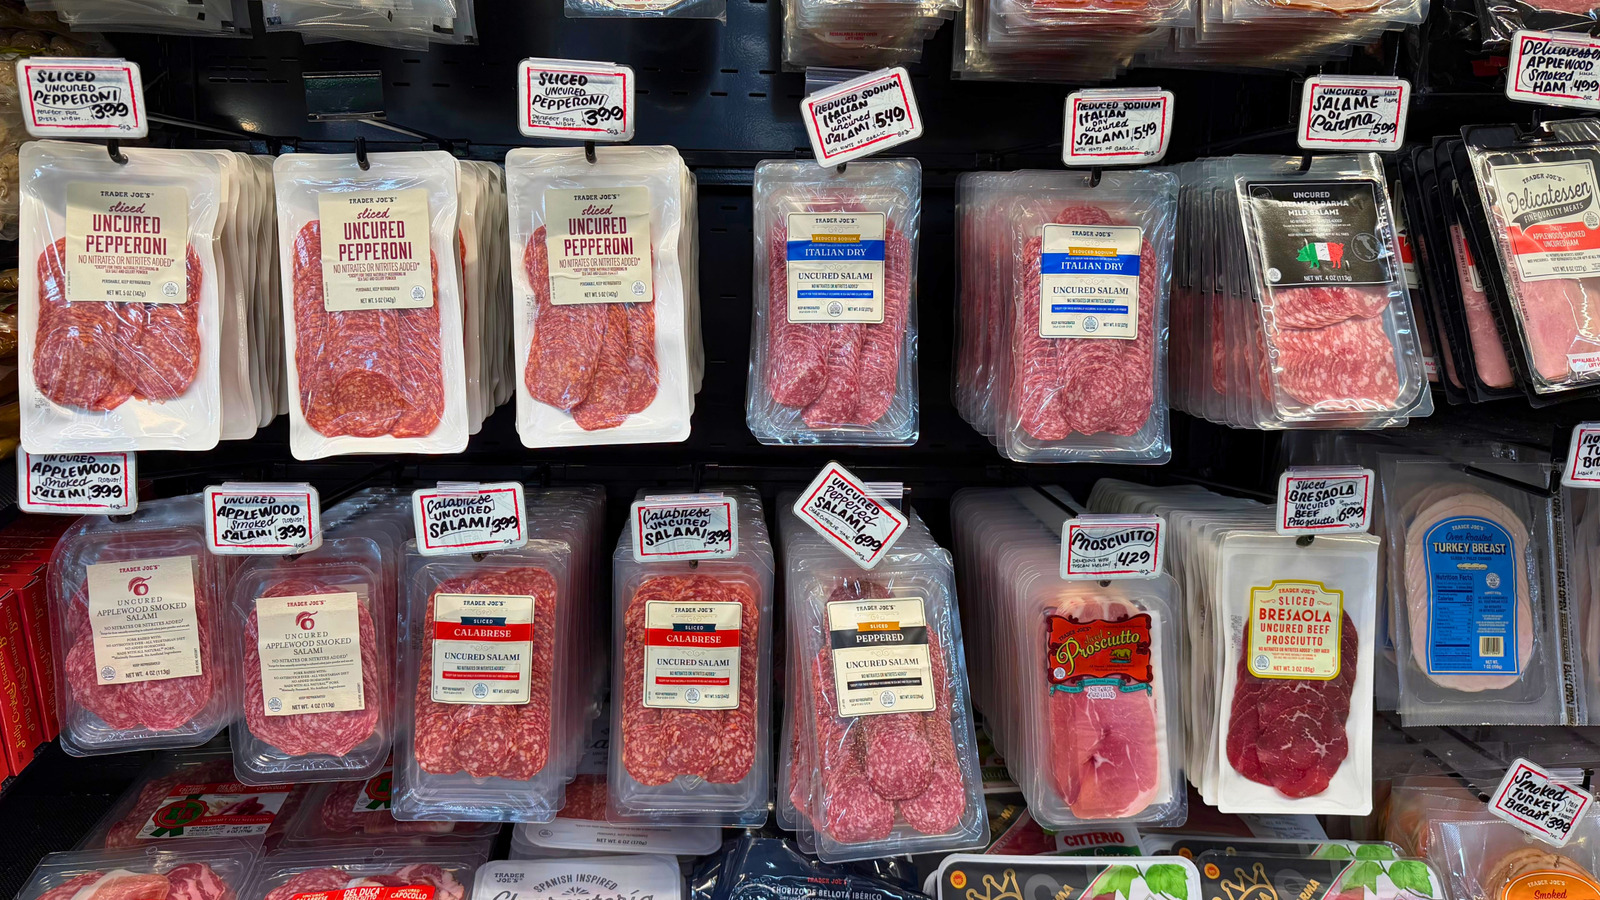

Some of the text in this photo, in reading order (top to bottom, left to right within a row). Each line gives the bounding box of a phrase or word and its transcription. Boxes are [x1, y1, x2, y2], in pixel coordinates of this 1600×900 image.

[1526, 56, 1594, 71] APPLEWOOD
[37, 69, 96, 83] SLICED
[538, 71, 588, 87] SLICED
[1528, 69, 1574, 82] Smoked
[44, 83, 96, 93] UNCURED
[545, 87, 586, 97] UNCURED
[1323, 88, 1368, 96] UNCURED
[1533, 81, 1566, 94] HAM
[33, 90, 118, 105] PEPPERONI
[532, 94, 605, 111] PEPPERONI
[814, 80, 899, 117] REDUCED SODIUM
[1313, 95, 1380, 112] SALAME
[1077, 101, 1161, 111] REDUCED SODIUM
[1311, 113, 1376, 132] Parma
[825, 121, 870, 145] SALAMI
[130, 191, 151, 199] JOE'S
[1506, 181, 1592, 215] Delicatessen
[108, 201, 146, 214] sliced
[356, 207, 391, 220] sliced
[581, 204, 614, 216] sliced
[1288, 209, 1307, 217] MILD
[1523, 203, 1584, 224] FINE QUALITY MEATS
[93, 214, 161, 235] UNCURED
[343, 220, 405, 241] UNCURED
[568, 216, 627, 236] UNCURED
[1533, 232, 1561, 240] APPLEWOOD
[86, 235, 167, 256] PEPPERONI
[338, 242, 413, 262] PEPPERONI
[564, 237, 634, 257] PEPPERONI
[805, 248, 867, 257] ITALIAN DRY
[78, 254, 87, 264] NO
[87, 255, 116, 265] NITRATES
[116, 256, 125, 265] OR
[125, 256, 152, 266] NITRITES
[1061, 261, 1124, 271] ITALIAN DRY
[798, 272, 873, 280] UNCURED SALAMI
[1053, 286, 1129, 295] UNCURED SALAMI
[43, 454, 96, 464] UNCURED
[31, 462, 121, 479] APPLEWOOD
[41, 476, 94, 488] Smoked
[1295, 480, 1327, 491] Sliced
[31, 485, 86, 499] SALAMI
[831, 477, 880, 516] UNCURED
[1289, 484, 1354, 502] BRESAOLA
[223, 496, 277, 505] UNCURED
[427, 494, 493, 515] Calabrese
[823, 485, 879, 527] Peppered
[1294, 498, 1336, 510] UNCURED
[217, 504, 300, 520] APPLEWOOD
[433, 505, 492, 521] UNCURED
[643, 507, 711, 525] Calabrese
[1294, 509, 1321, 519] BEEF
[650, 518, 708, 530] UNCURED
[221, 529, 272, 541] SALAMI
[645, 527, 707, 546] SALAMI
[1071, 530, 1155, 551] PROSCIUTTO
[1433, 542, 1506, 554] TURKEY BREAST
[117, 596, 163, 607] UNCURED
[1278, 596, 1315, 607] SLICED
[97, 602, 188, 617] APPLEWOOD SMOKED
[1259, 607, 1332, 623] BRESAOLA
[126, 612, 158, 622] SALAMI
[454, 628, 512, 638] CALABRESE
[1260, 622, 1330, 635] UNCURED BEEF
[285, 631, 329, 640] UNCURED
[666, 634, 722, 644] CALABRESE
[856, 633, 905, 643] PEPPERED
[1266, 635, 1323, 646] PROSCIUTTO
[265, 637, 352, 650] APPLEWOOD SMOKED
[293, 647, 323, 656] SALAMI
[444, 652, 520, 661] UNCURED SALAMI
[1056, 629, 1140, 676] Prosciutto
[657, 658, 730, 667] UNCURED SALAMI
[845, 658, 919, 669] UNCURED SALAMI
[1515, 770, 1569, 801] Smoked
[1512, 787, 1561, 813] TURKEY
[1504, 797, 1550, 822] Breast
[1063, 831, 1125, 847] CITTERIO
[533, 873, 619, 893] SPANISH INSPIRED
[344, 887, 381, 897] DEL DUCA
[390, 891, 428, 900] CAPOCOLLO
[772, 886, 807, 895] CHORIZO
[818, 889, 850, 899] BELLOTA
[852, 890, 882, 900] IBÉRICO
[1534, 889, 1568, 900] Smoked
